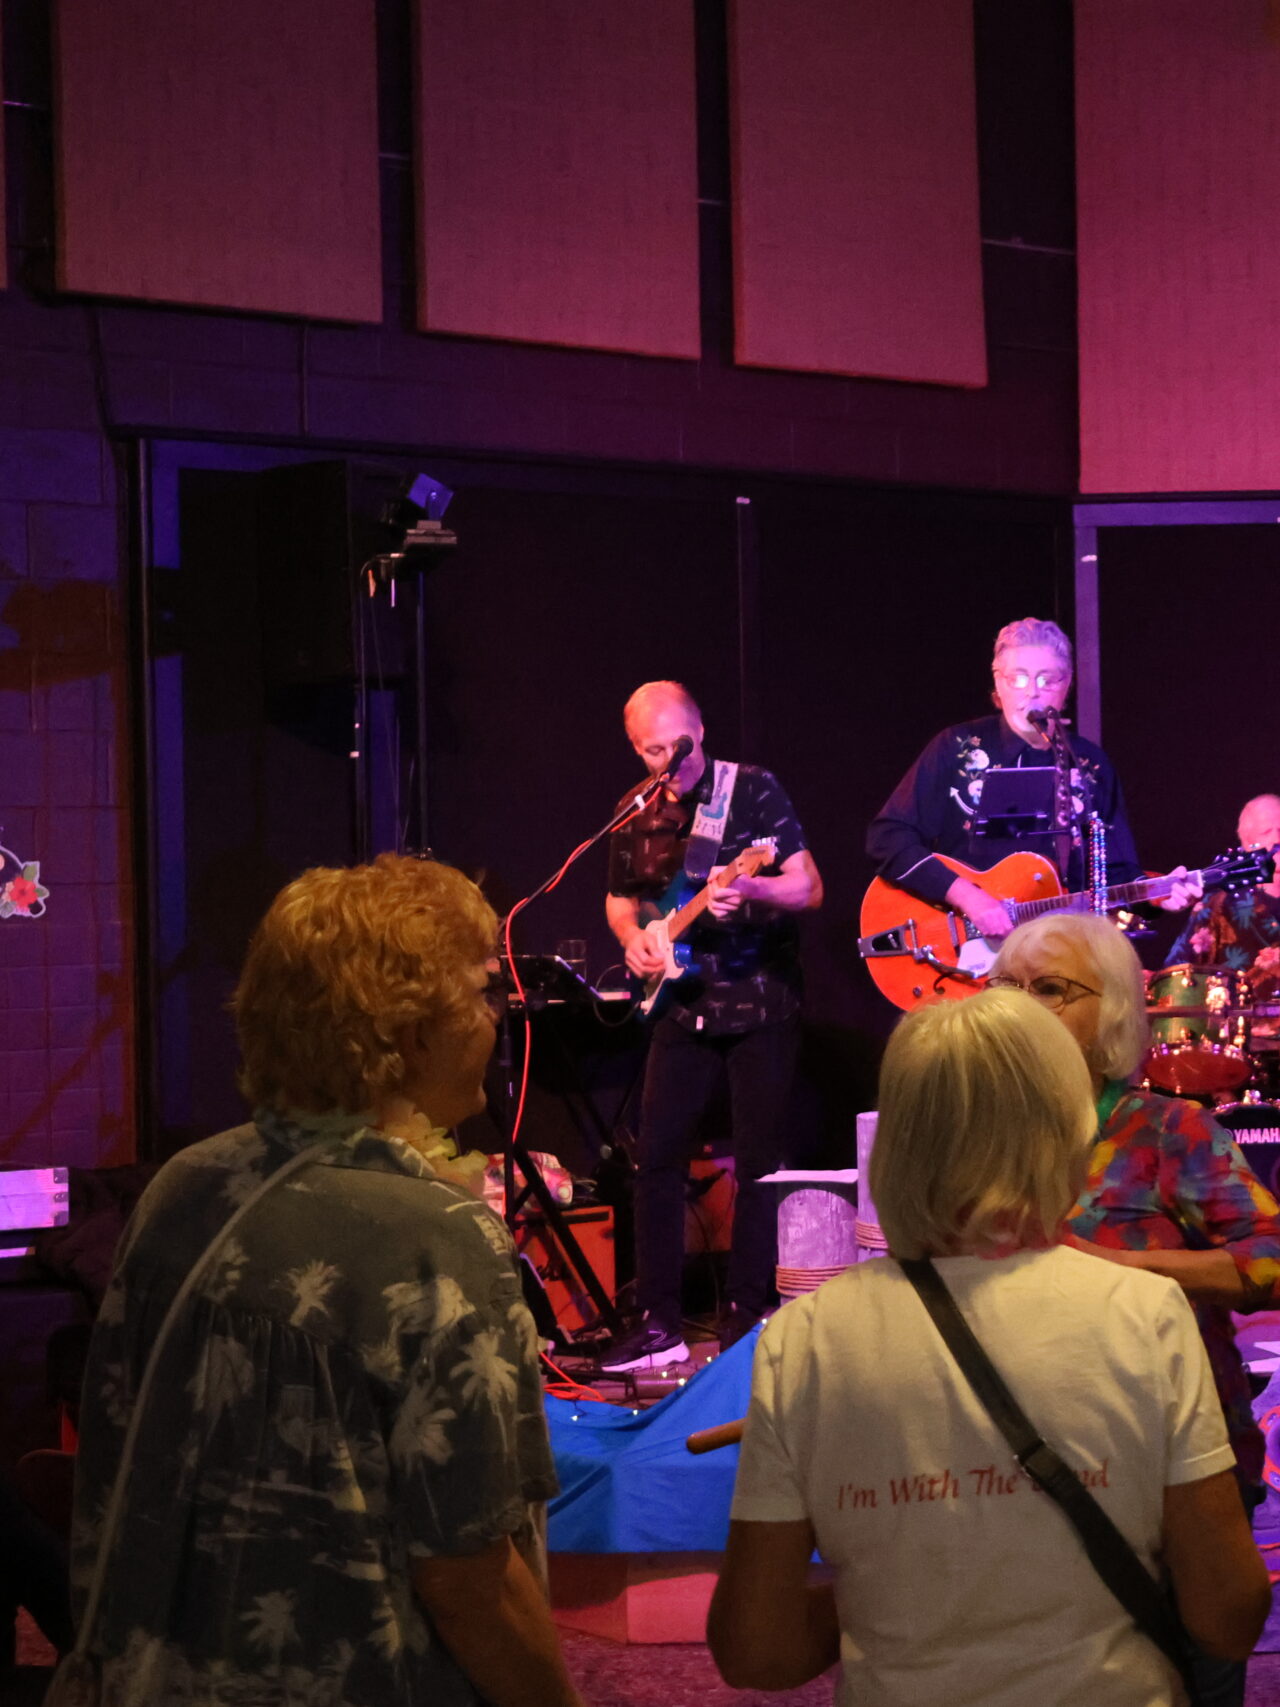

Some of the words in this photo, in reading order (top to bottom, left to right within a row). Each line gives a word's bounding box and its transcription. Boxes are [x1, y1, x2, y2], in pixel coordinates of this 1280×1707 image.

[838, 1482, 877, 1510] I'm
[890, 1469, 959, 1504] With
[967, 1464, 1022, 1496] The
